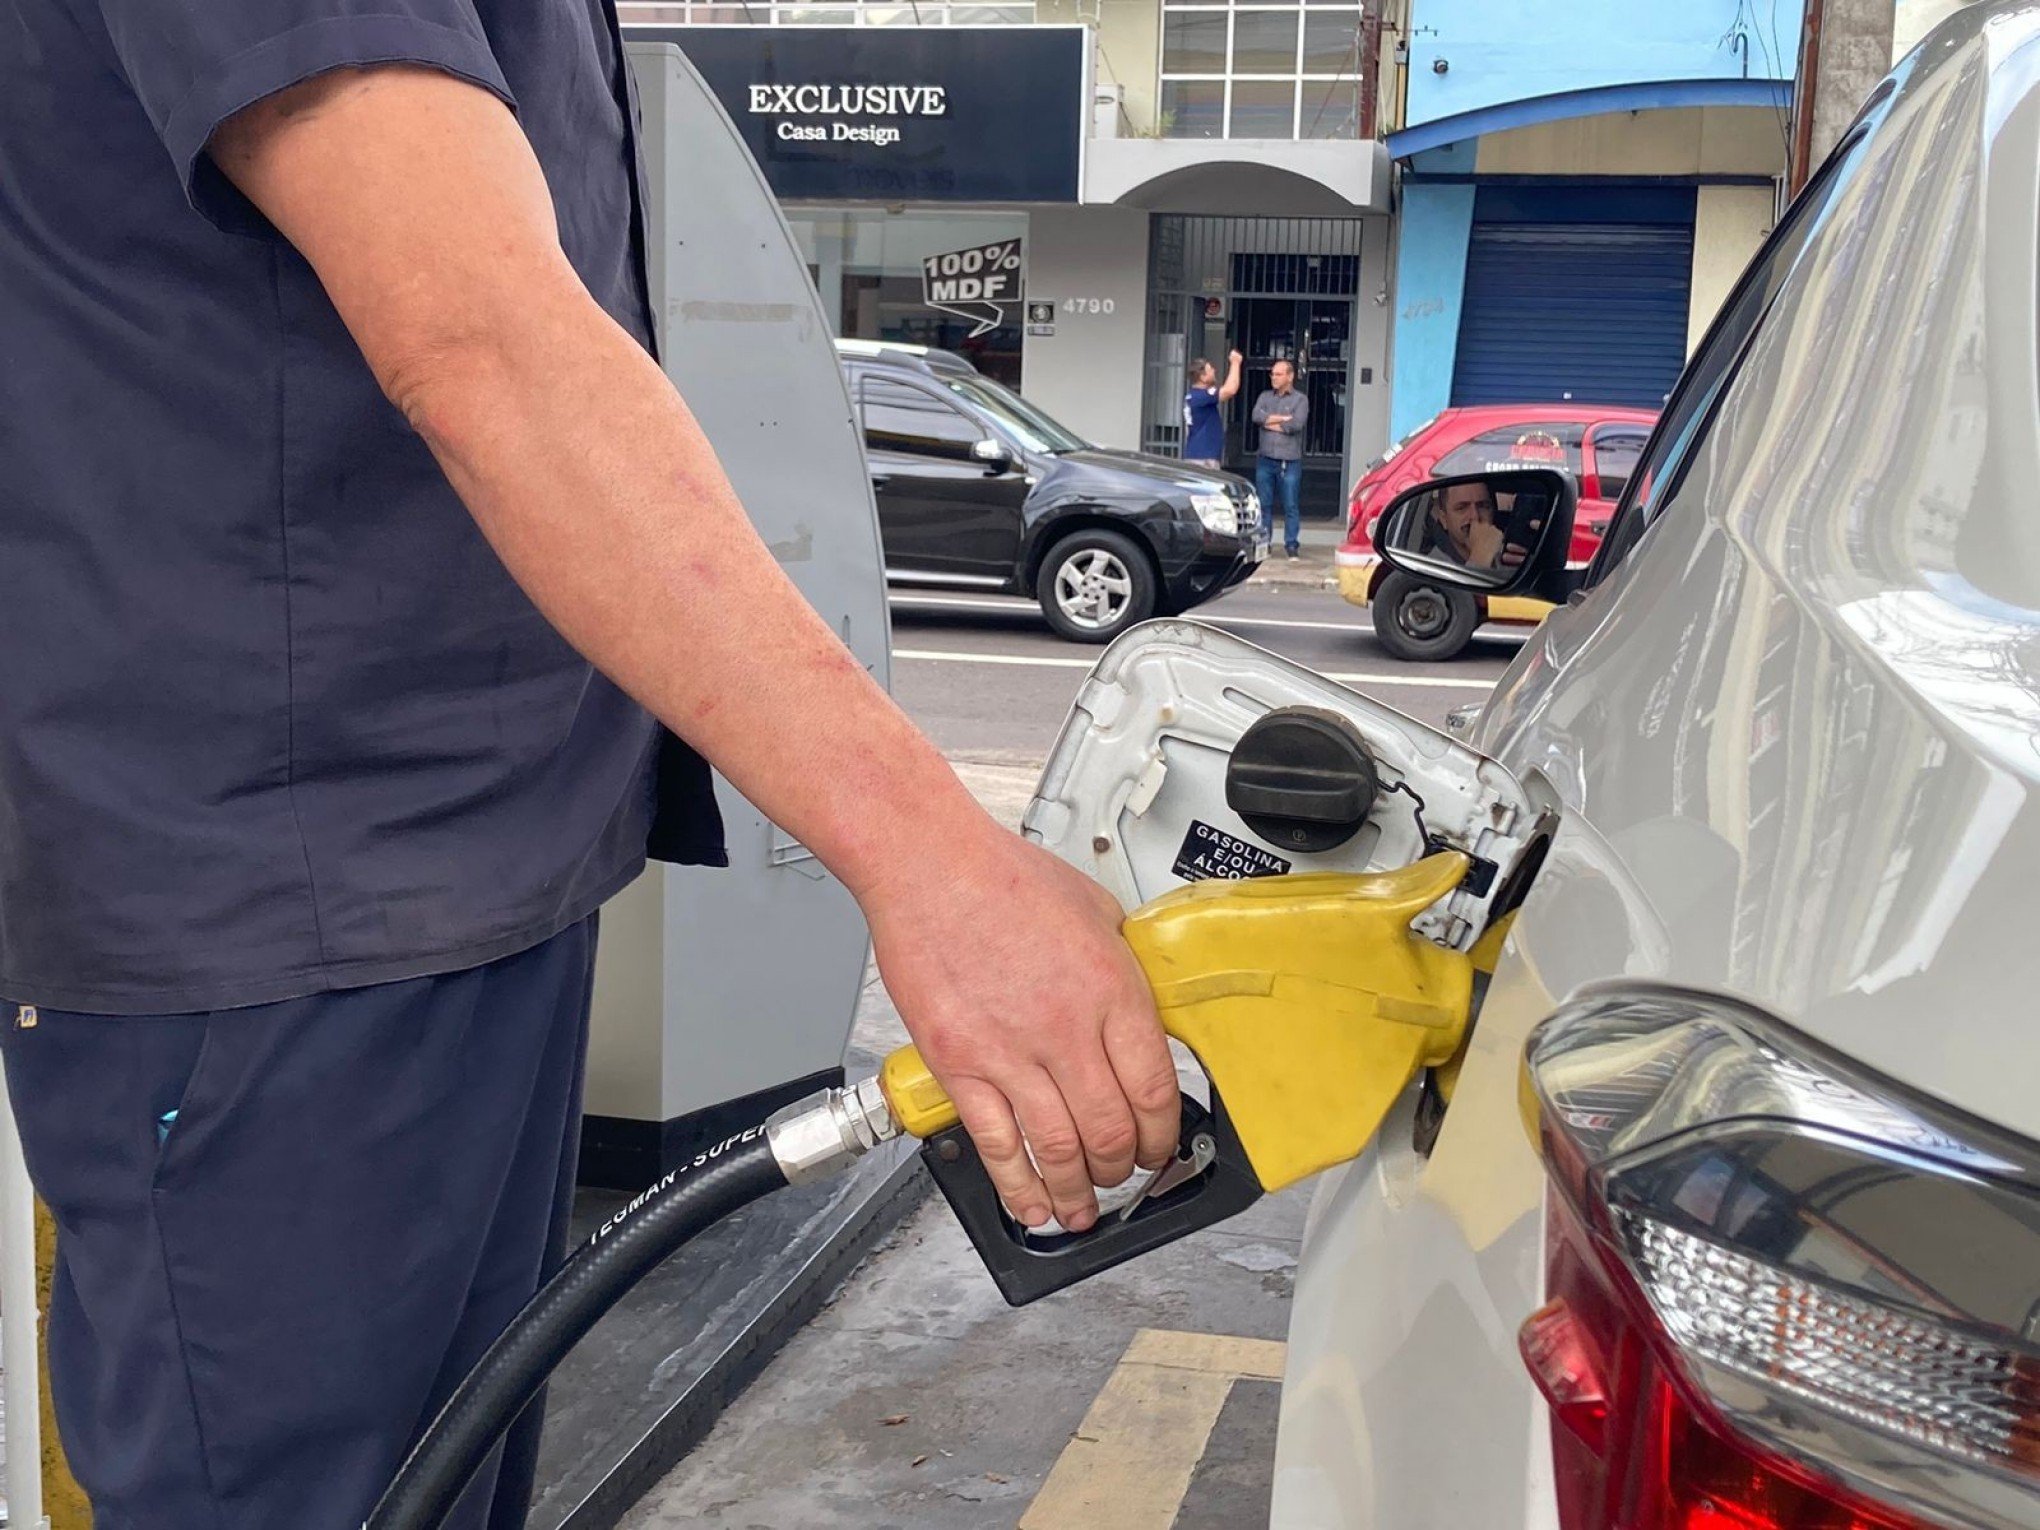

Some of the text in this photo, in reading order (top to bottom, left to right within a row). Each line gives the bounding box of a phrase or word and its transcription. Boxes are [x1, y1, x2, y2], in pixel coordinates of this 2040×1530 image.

[748, 84, 946, 115] EXCLUSIVE
[777, 122, 901, 146] Casa Design
[926, 243, 1020, 278] 100%
[932, 275, 1007, 300] MDF
[1062, 298, 1115, 315] 4790
[1196, 825, 1283, 873] GASOLINA
[1213, 847, 1256, 873] E/OU
[1193, 852, 1251, 880] ÁLCO
